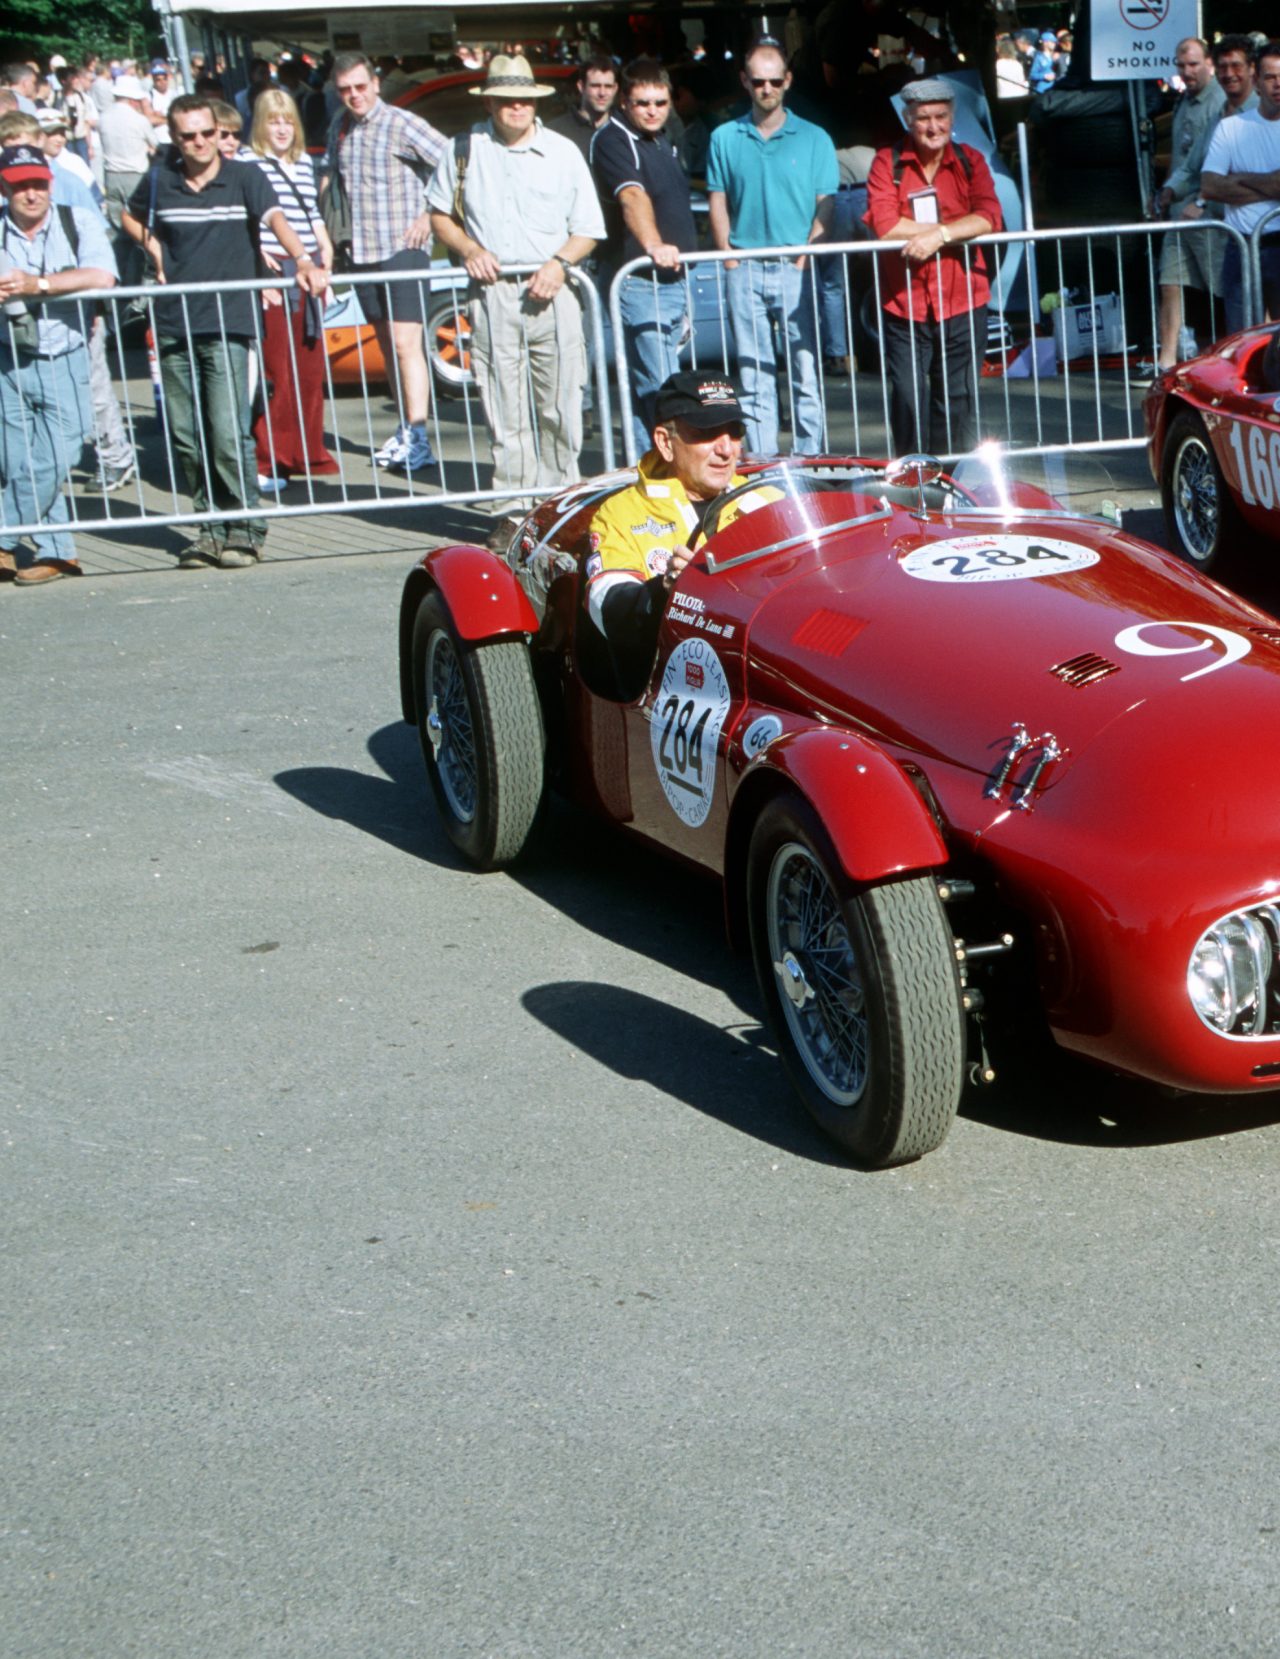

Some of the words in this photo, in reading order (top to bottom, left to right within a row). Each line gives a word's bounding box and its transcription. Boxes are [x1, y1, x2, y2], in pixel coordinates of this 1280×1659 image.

[1132, 40, 1156, 52] NO
[932, 543, 1071, 576] 284
[672, 591, 706, 613] PILOTA:
[667, 606, 697, 626] Richard
[695, 615, 706, 629] De
[1114, 621, 1252, 682] 9
[659, 694, 713, 784] 284
[750, 726, 772, 749] 66
